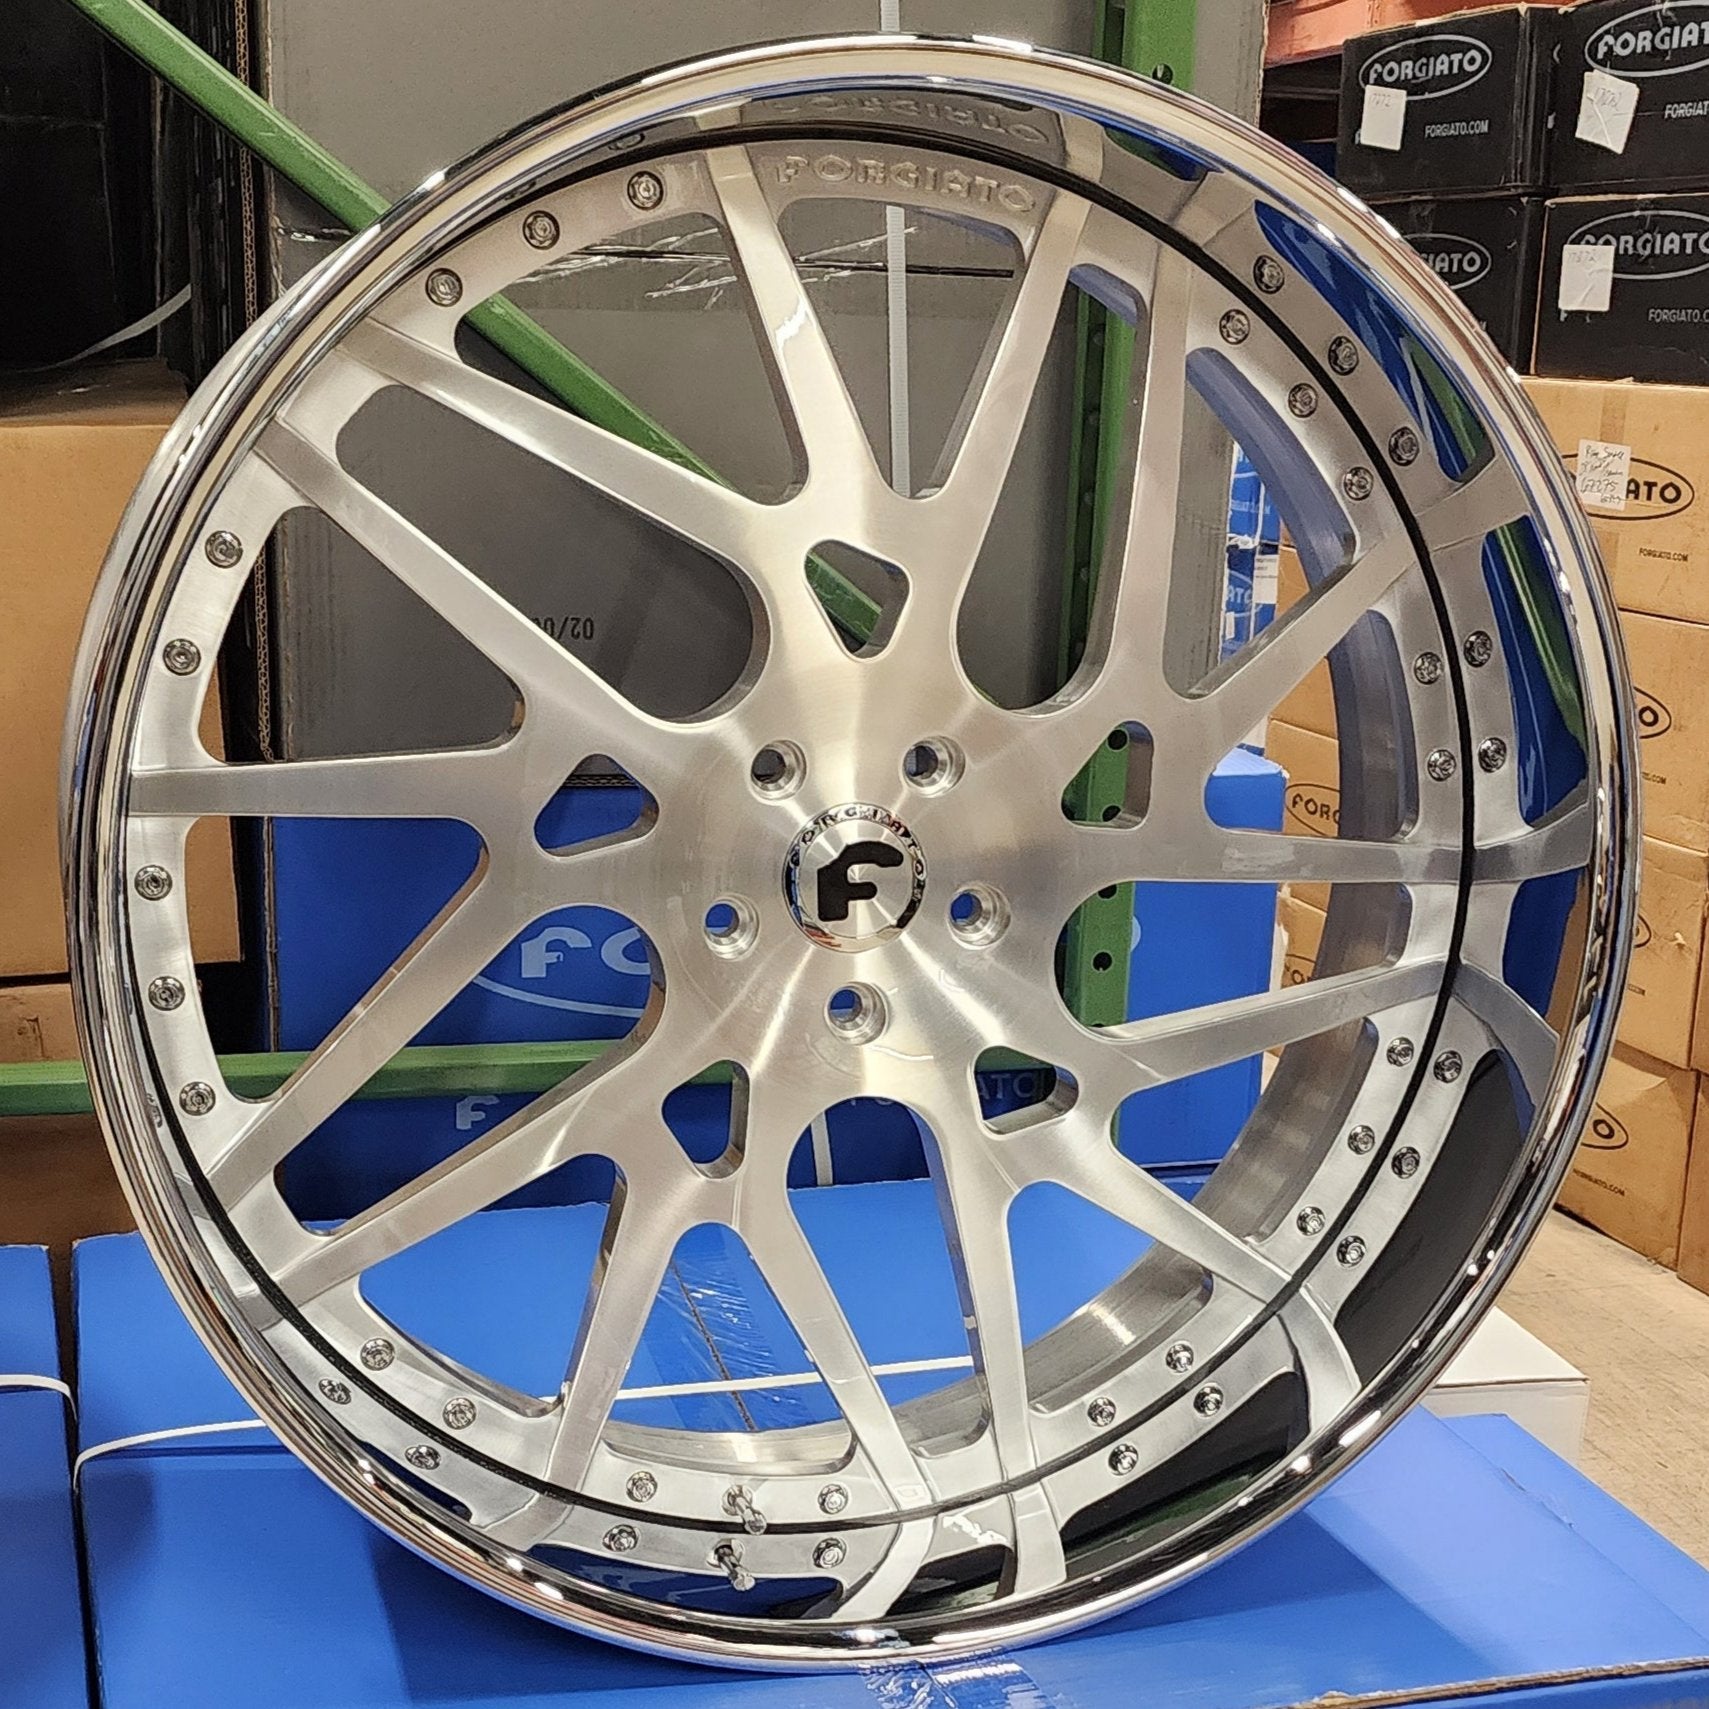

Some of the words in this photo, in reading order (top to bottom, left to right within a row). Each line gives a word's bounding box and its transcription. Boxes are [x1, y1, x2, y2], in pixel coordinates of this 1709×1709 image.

[1368, 49, 1483, 84] FORGIATO
[1425, 119, 1490, 139] FORGIATO.COM
[776, 153, 1037, 213] FORGIATO
